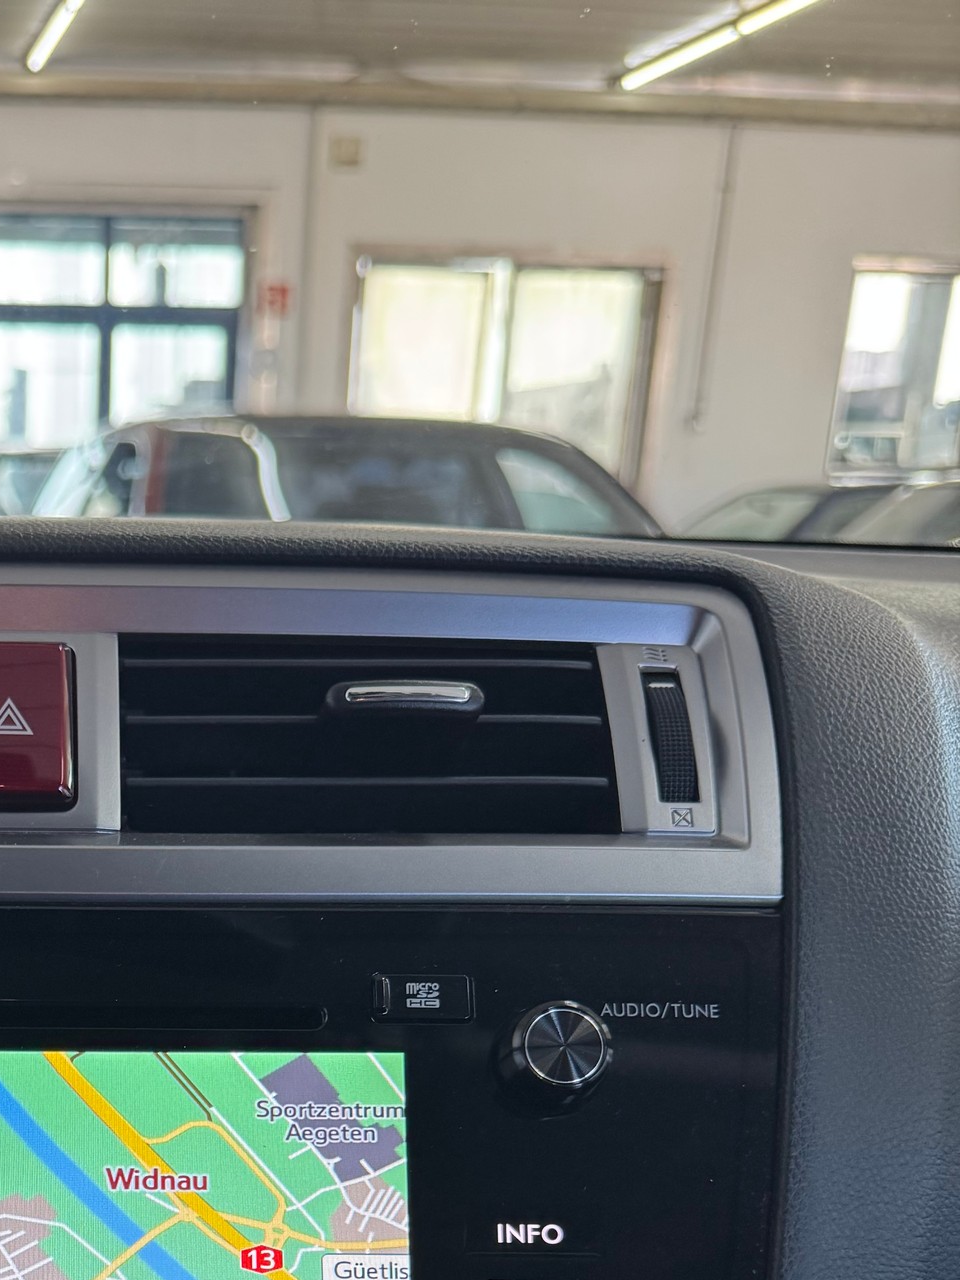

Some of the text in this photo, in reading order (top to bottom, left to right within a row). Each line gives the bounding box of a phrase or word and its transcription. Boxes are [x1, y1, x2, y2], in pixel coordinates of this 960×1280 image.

[600, 1003, 720, 1019] AUDIO/TUNE
[256, 1101, 405, 1119] Sportzentrum
[285, 1125, 376, 1143] Aegeten
[106, 1168, 208, 1191] Widnau
[497, 1223, 564, 1244] INFO
[248, 1250, 275, 1269] 13
[334, 1261, 409, 1280] Güetlis
